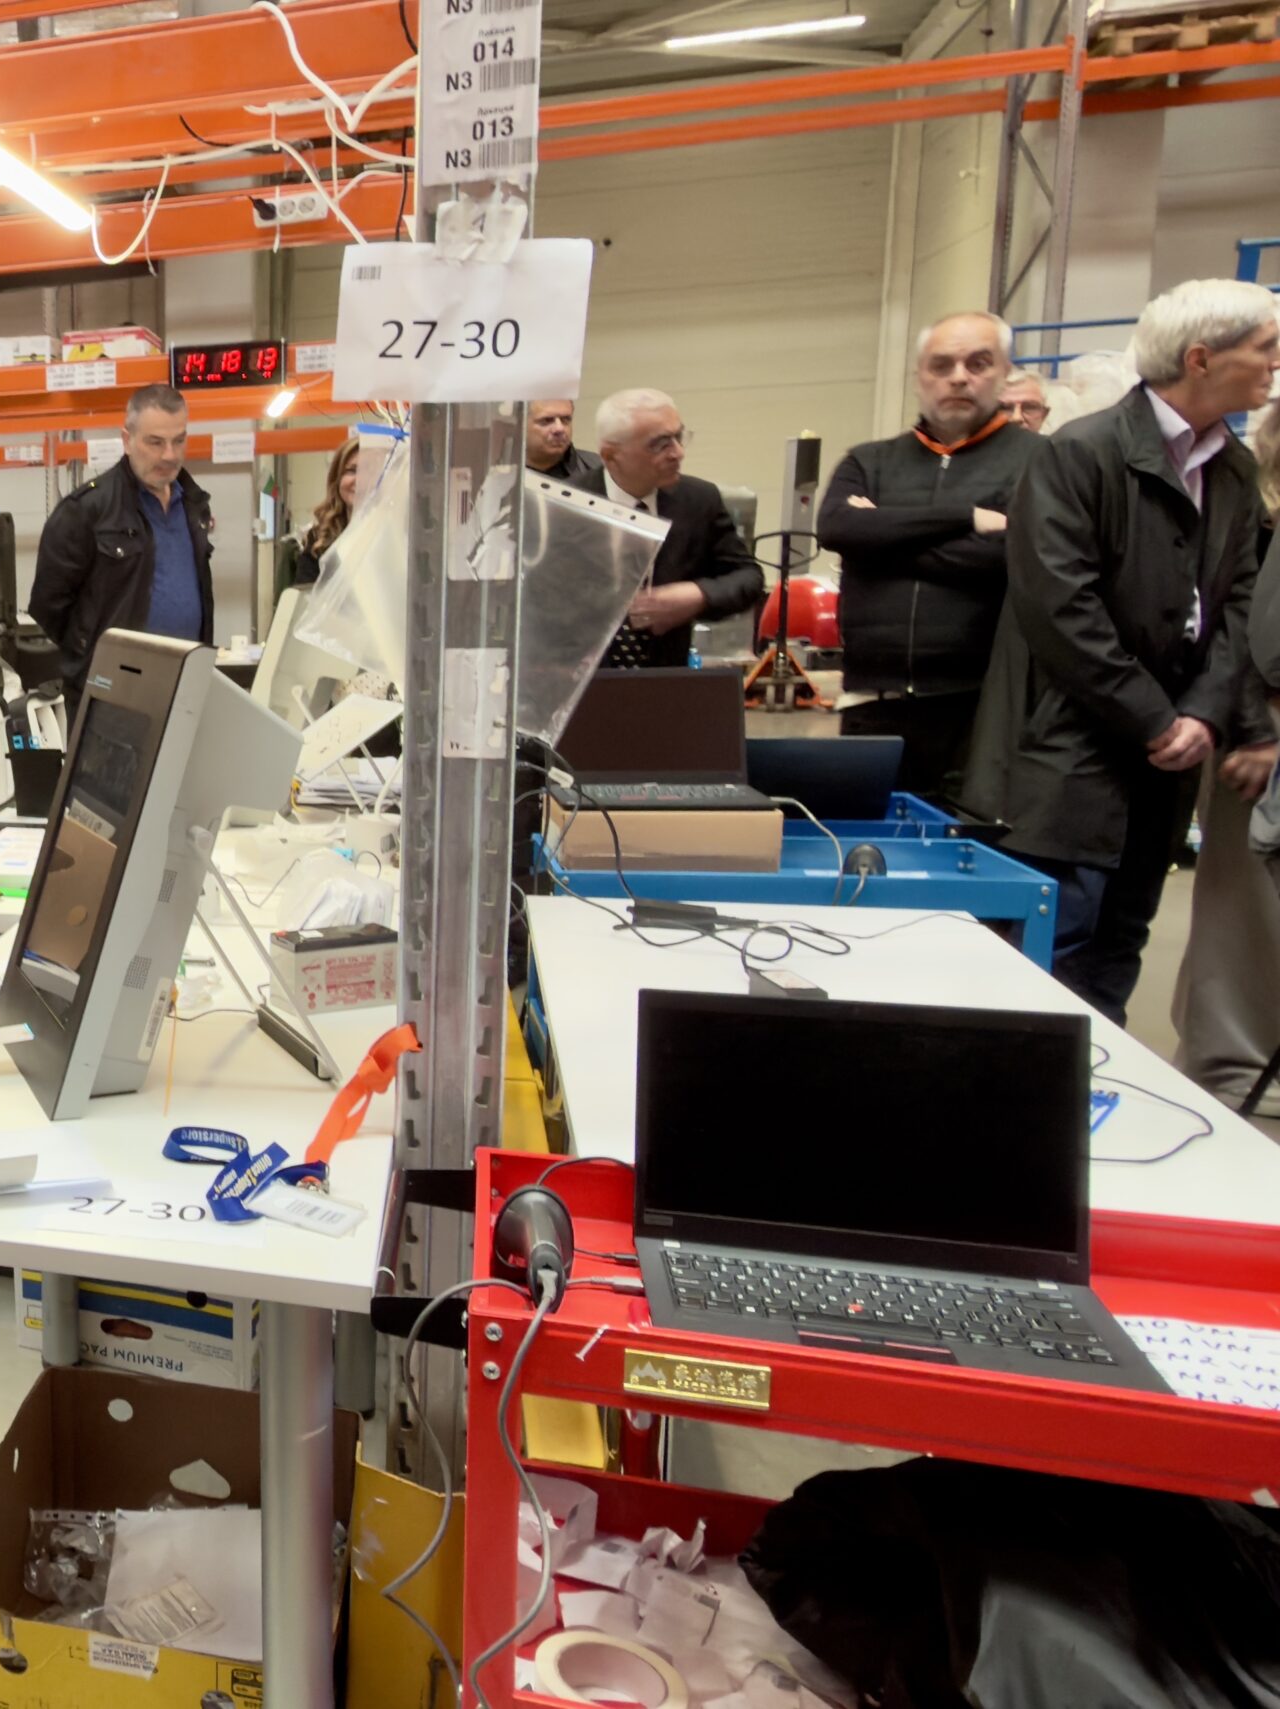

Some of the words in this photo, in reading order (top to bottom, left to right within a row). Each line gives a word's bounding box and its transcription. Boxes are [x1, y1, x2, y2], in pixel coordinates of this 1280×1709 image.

[446, 0, 474, 14] N3
[473, 37, 514, 63] 014
[446, 71, 473, 92] N3
[472, 116, 514, 141] 013
[445, 148, 472, 169] N3
[378, 319, 521, 360] 27-30
[68, 1196, 207, 1222] 27-30
[80, 1341, 108, 1358] PAC
[114, 1347, 184, 1373] PREMIUM
